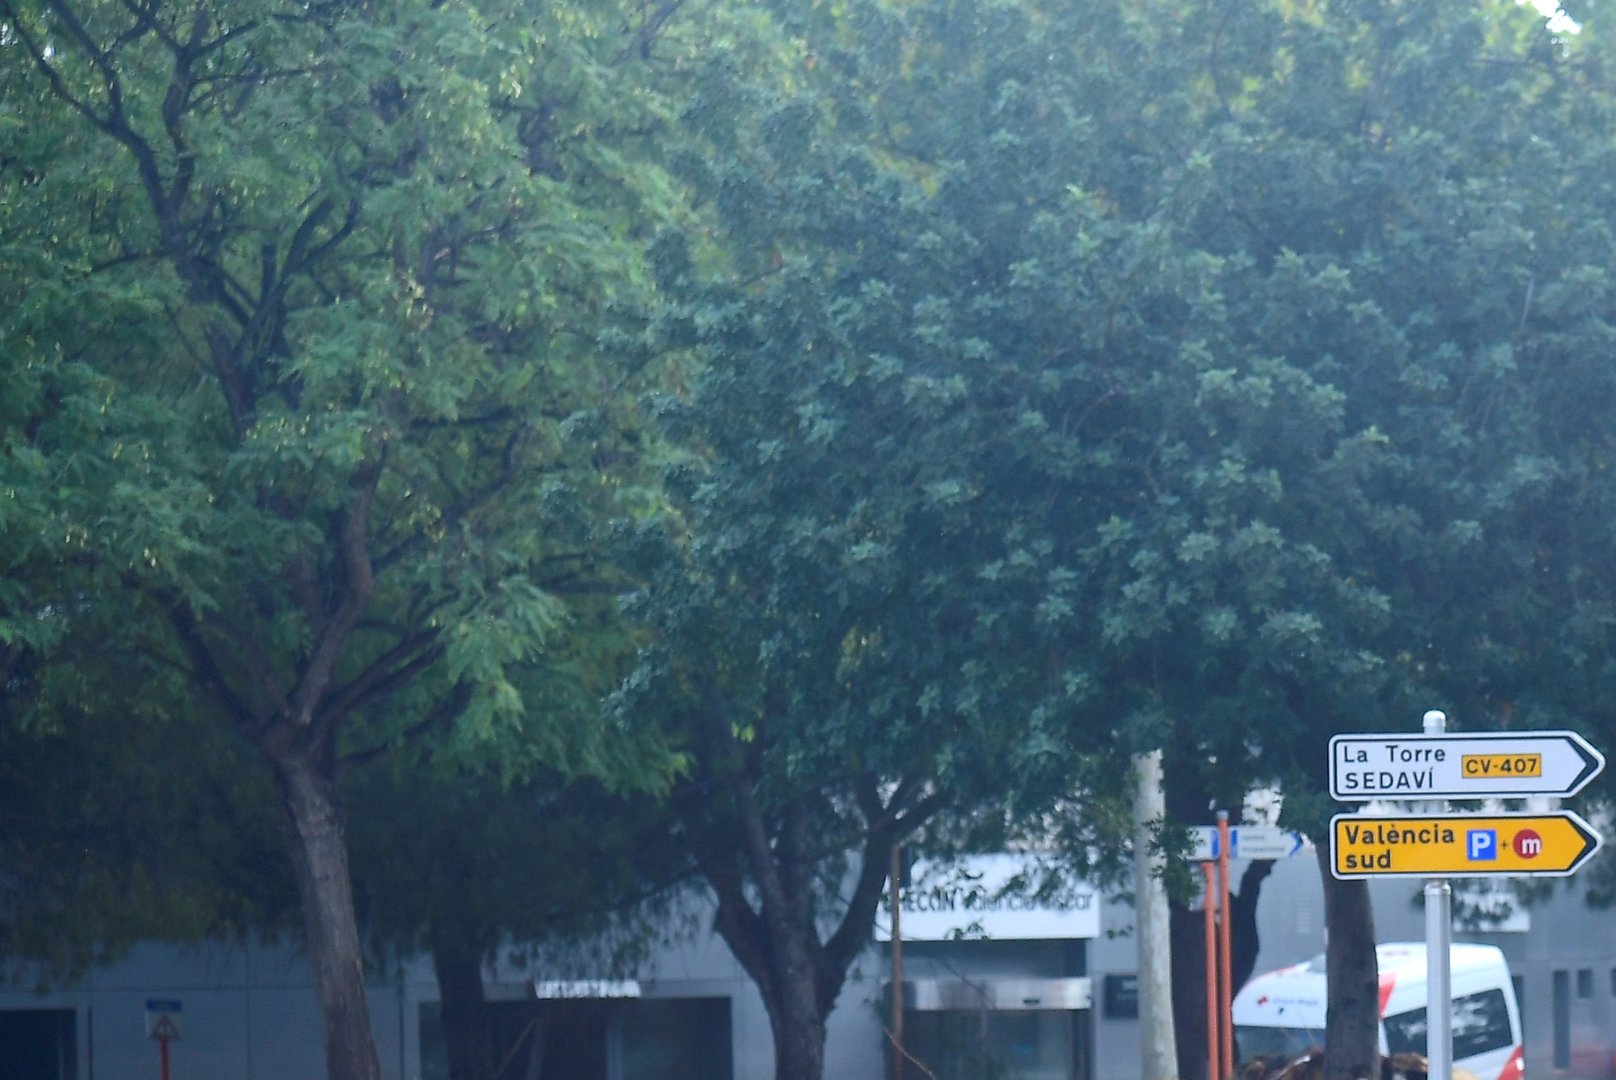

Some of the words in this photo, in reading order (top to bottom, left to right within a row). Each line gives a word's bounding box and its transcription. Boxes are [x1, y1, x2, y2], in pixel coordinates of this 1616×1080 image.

[1344, 745, 1369, 763] La
[1385, 744, 1446, 762] Torre
[1466, 758, 1537, 774] CV-407
[1345, 766, 1434, 790] SEDAVÍ
[1345, 823, 1455, 845] València
[1345, 849, 1391, 869] sud
